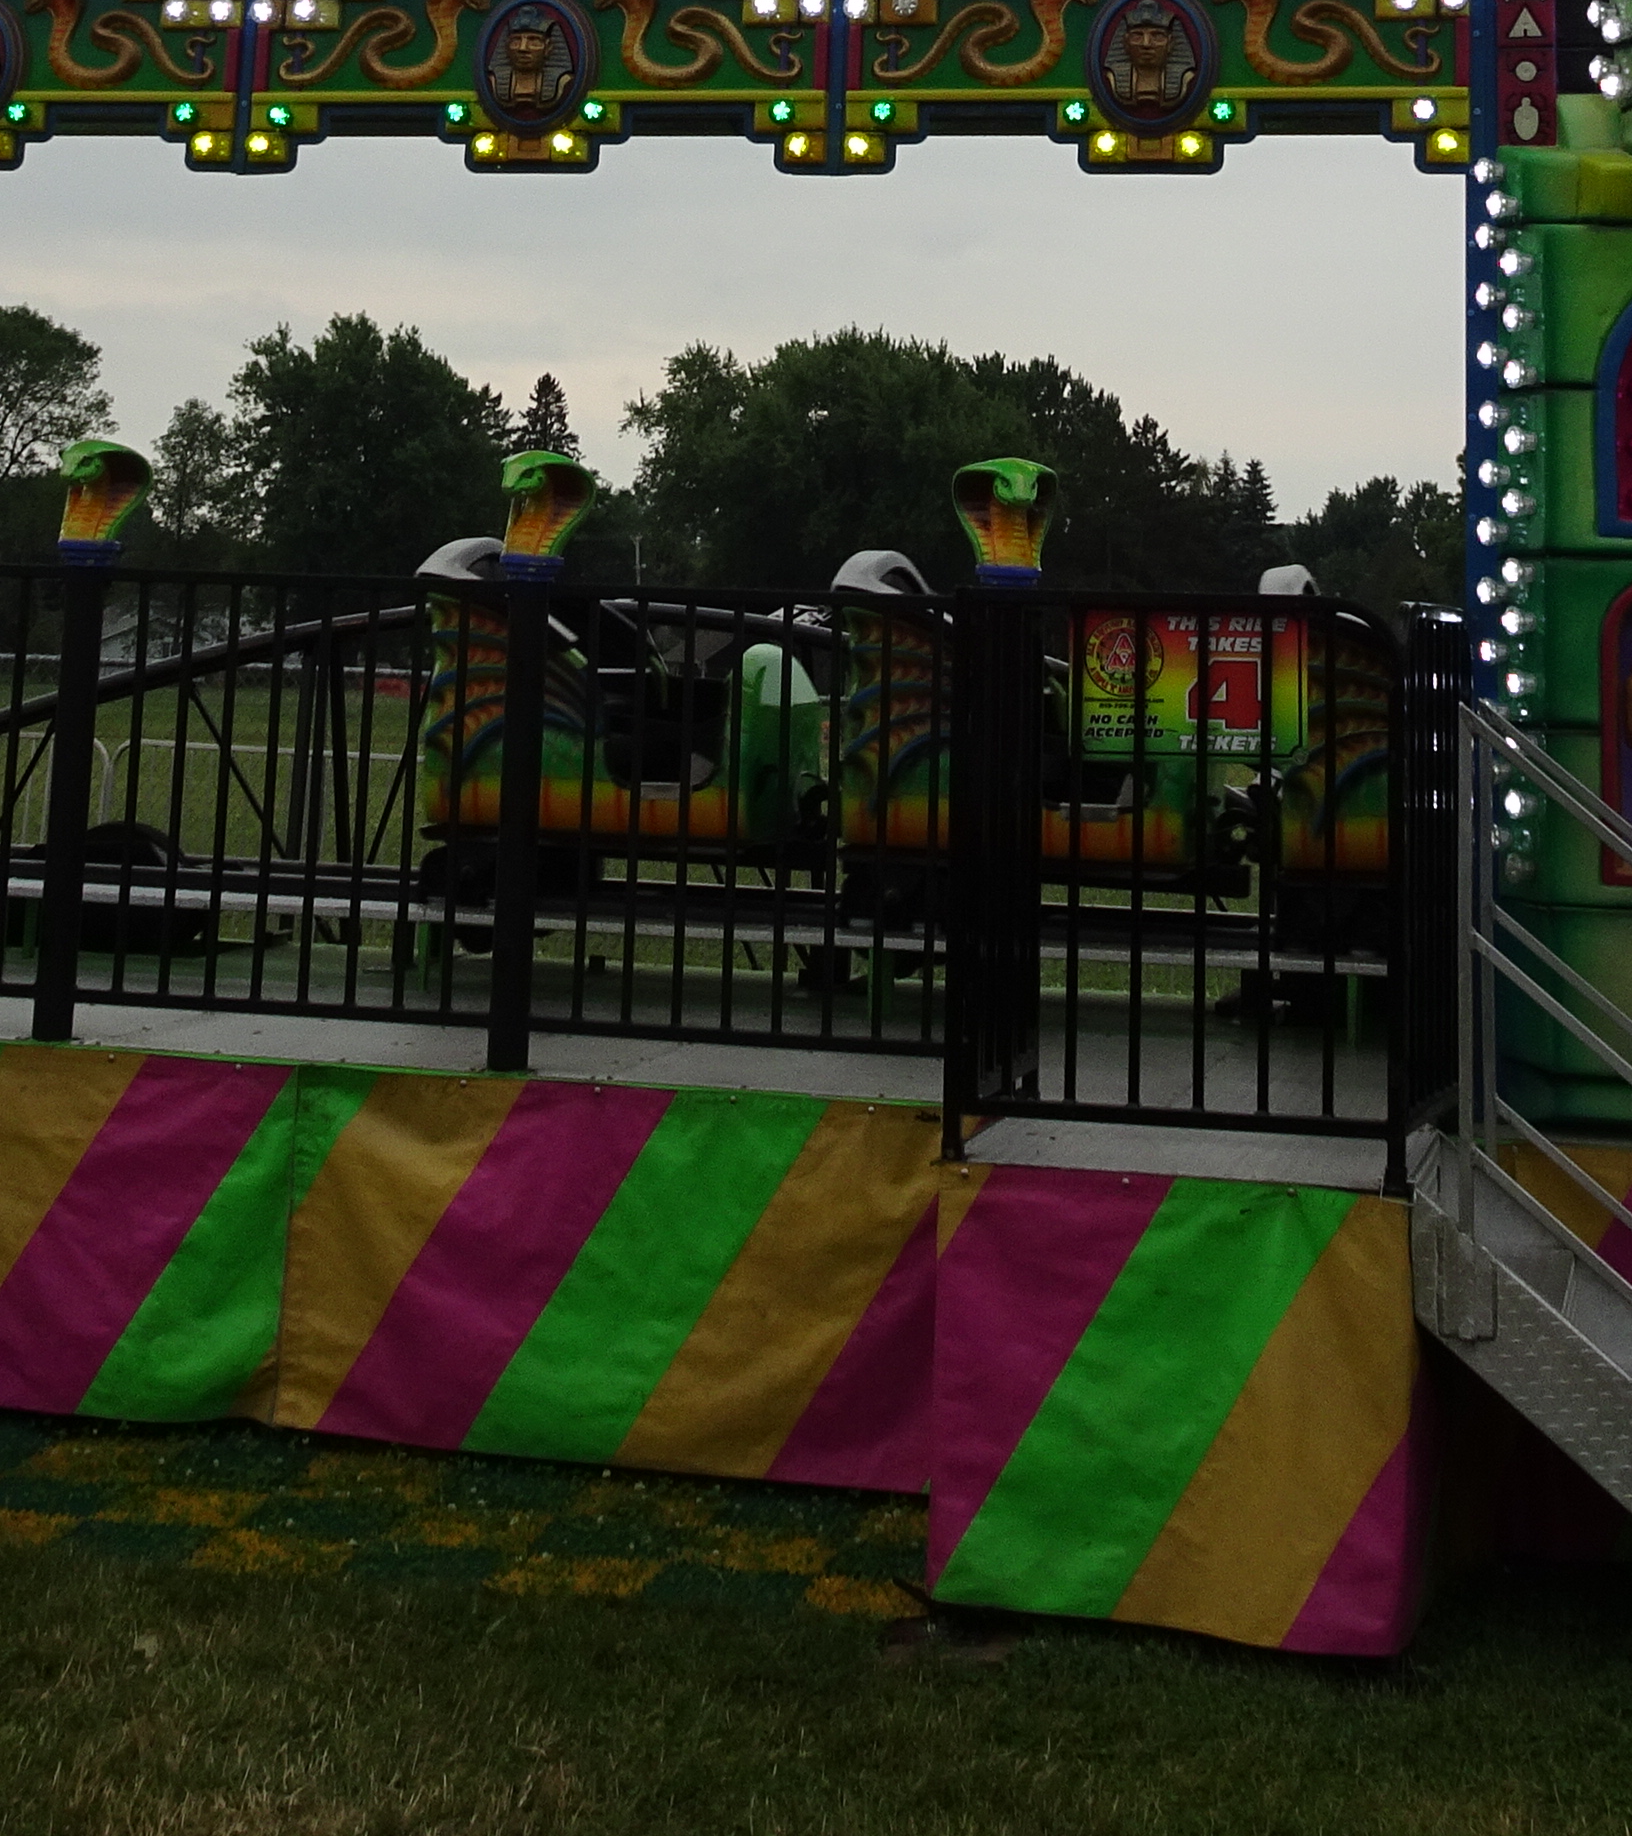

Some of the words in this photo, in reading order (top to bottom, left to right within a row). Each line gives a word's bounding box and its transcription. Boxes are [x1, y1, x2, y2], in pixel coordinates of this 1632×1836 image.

[1167, 616, 1221, 632] THS
[1186, 656, 1264, 732] 4
[1089, 714, 1112, 724] NO
[1117, 714, 1159, 724] CAH
[1084, 727, 1164, 737] ACCEPED
